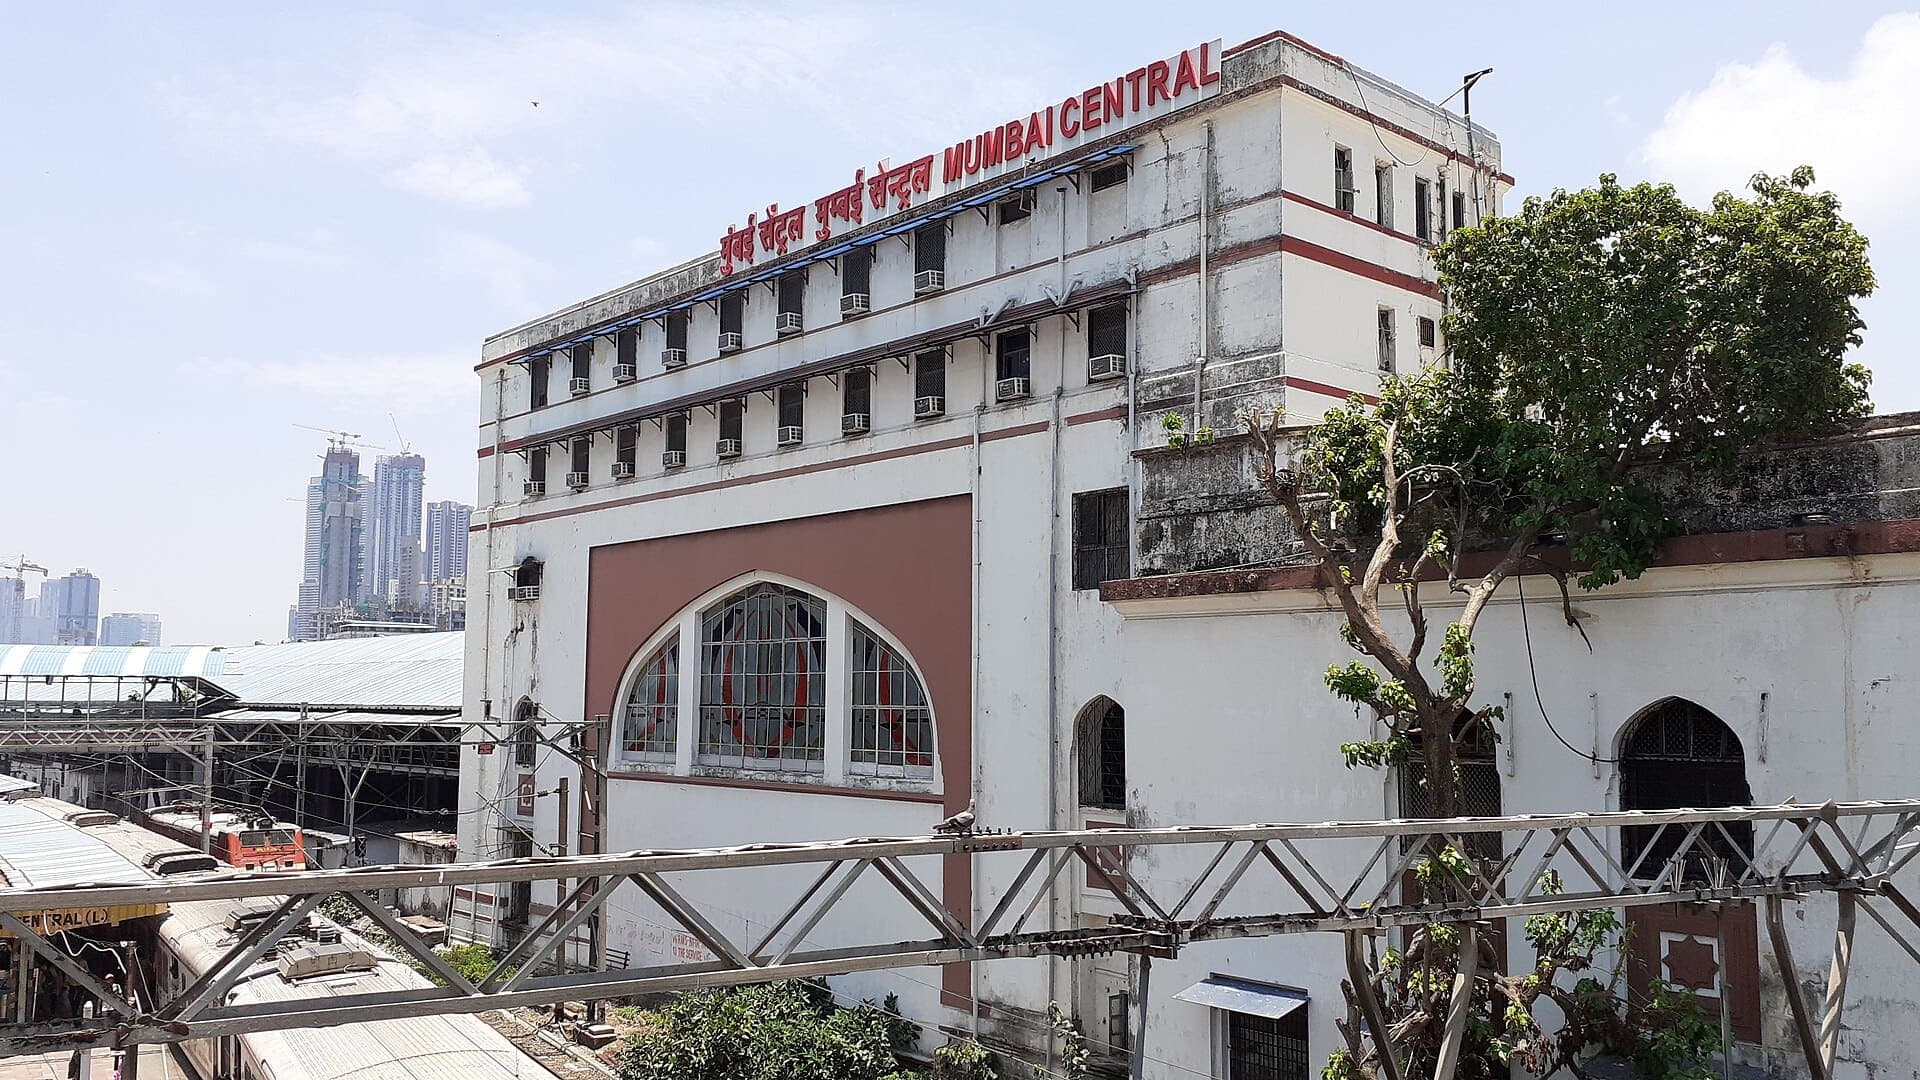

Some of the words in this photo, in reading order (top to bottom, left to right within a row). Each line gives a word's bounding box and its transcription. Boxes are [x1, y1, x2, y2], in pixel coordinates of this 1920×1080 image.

[943, 109, 1054, 184] MUMBAI
[1059, 43, 1220, 138] CENTRAL
[720, 213, 755, 276] मुंबई
[758, 204, 805, 255] सेंट्रल
[815, 169, 864, 241] मुम्बई
[868, 161, 933, 210] सेन्ट्रल
[17, 912, 82, 928] ENTRAL
